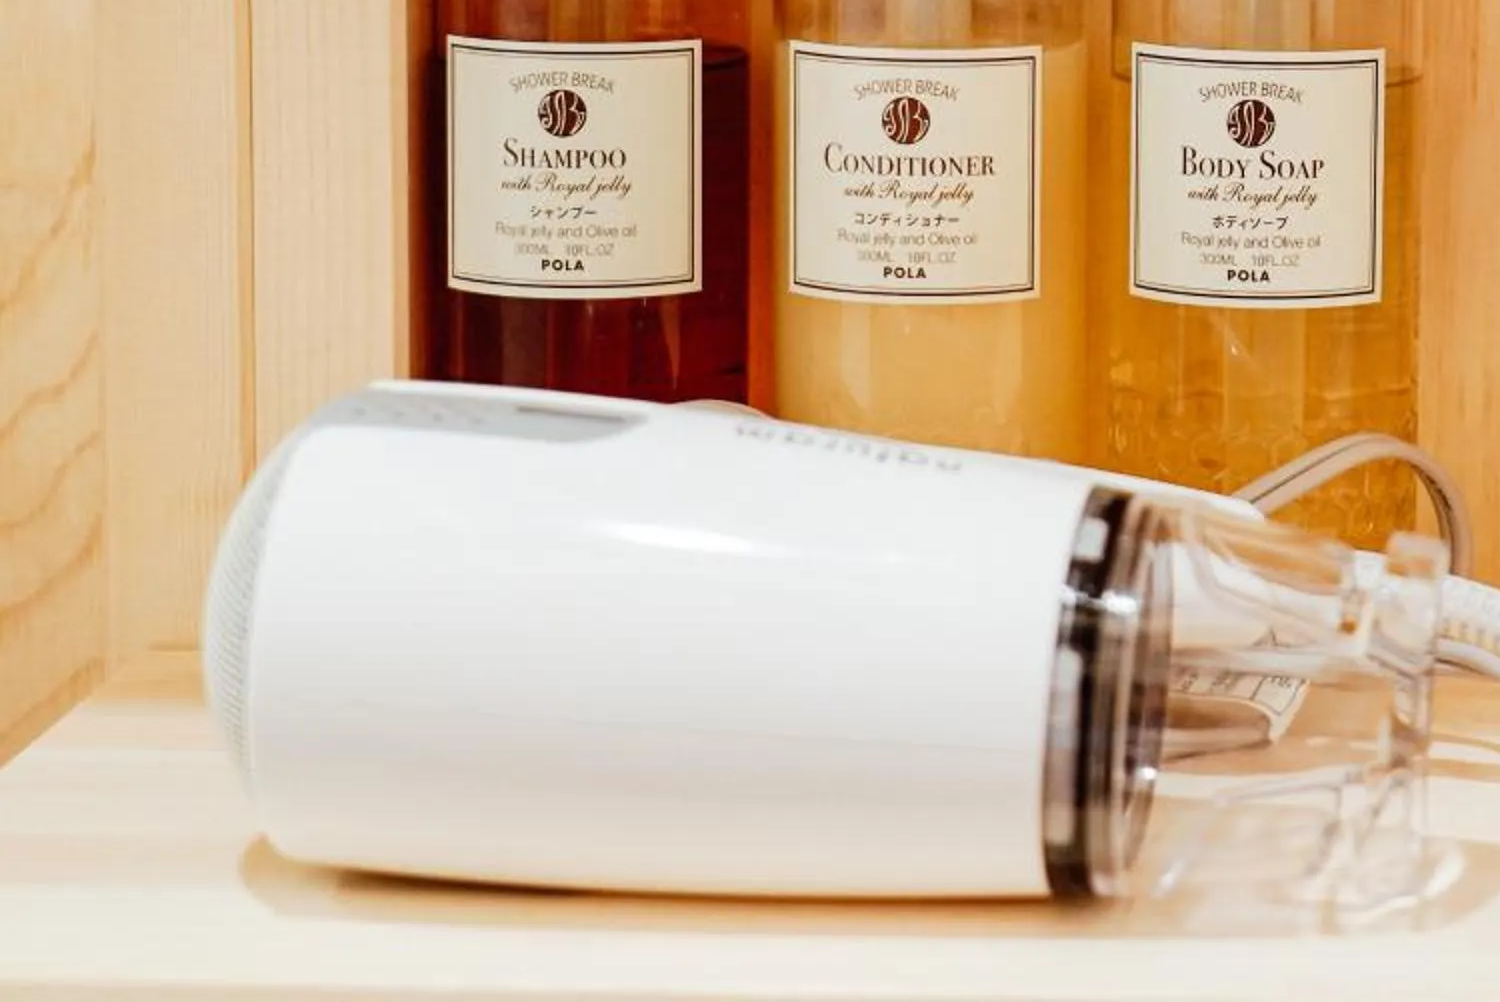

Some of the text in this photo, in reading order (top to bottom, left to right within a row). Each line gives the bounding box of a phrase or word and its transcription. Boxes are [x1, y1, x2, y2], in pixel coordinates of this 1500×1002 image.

[509, 71, 615, 95] SHOWER BREAK
[854, 78, 960, 102] SHOWER BREAK
[1199, 81, 1304, 104] SHOWER BREAK
[502, 137, 627, 169] SHAMPOO
[824, 142, 996, 177] CONDITIONER
[1182, 145, 1325, 180] BODY SOAP
[501, 173, 631, 199] with Royal jelly
[844, 180, 975, 207] with Royal jelly
[1187, 183, 1317, 210] with Royal jelly
[557, 224, 583, 238] and
[586, 223, 619, 238] Olive
[900, 232, 924, 245] and
[928, 232, 960, 246] Olive
[1244, 235, 1268, 249] and
[1272, 234, 1304, 249] Olive
[541, 259, 585, 271] POLA
[883, 267, 927, 279] POLA
[1227, 269, 1270, 282] POLA
